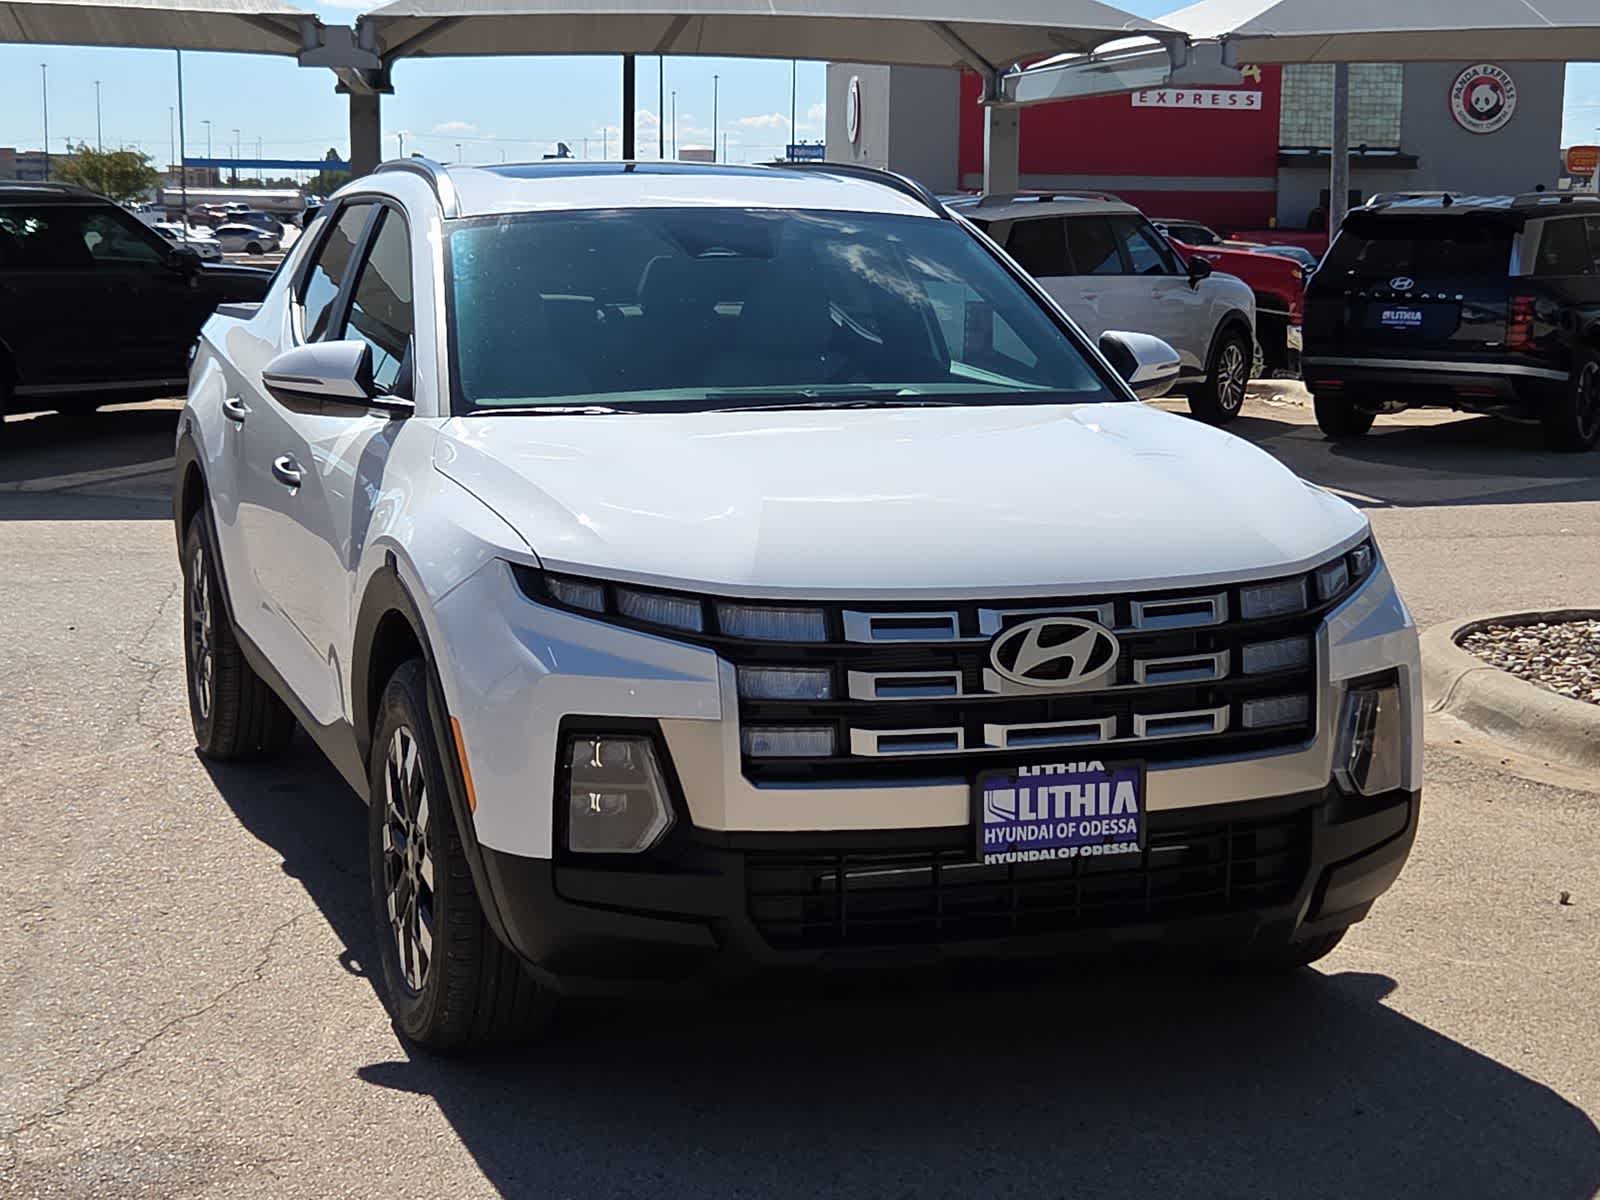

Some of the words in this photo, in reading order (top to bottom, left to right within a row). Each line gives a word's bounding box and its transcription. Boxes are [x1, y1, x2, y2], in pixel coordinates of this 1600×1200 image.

[1453, 68, 1480, 99] PANDA
[1482, 65, 1515, 100] EXPRESS
[1138, 91, 1255, 106] EXPRESS
[1018, 760, 1105, 777] LITHIA
[1019, 780, 1138, 821] LITHIA
[984, 823, 1053, 844] HYUNDAI
[1056, 822, 1077, 839] OF
[1079, 818, 1137, 837] ODESSA
[984, 848, 1056, 865] HYUNDAI
[1057, 846, 1079, 858] OF
[1080, 842, 1141, 857] ODESSA
